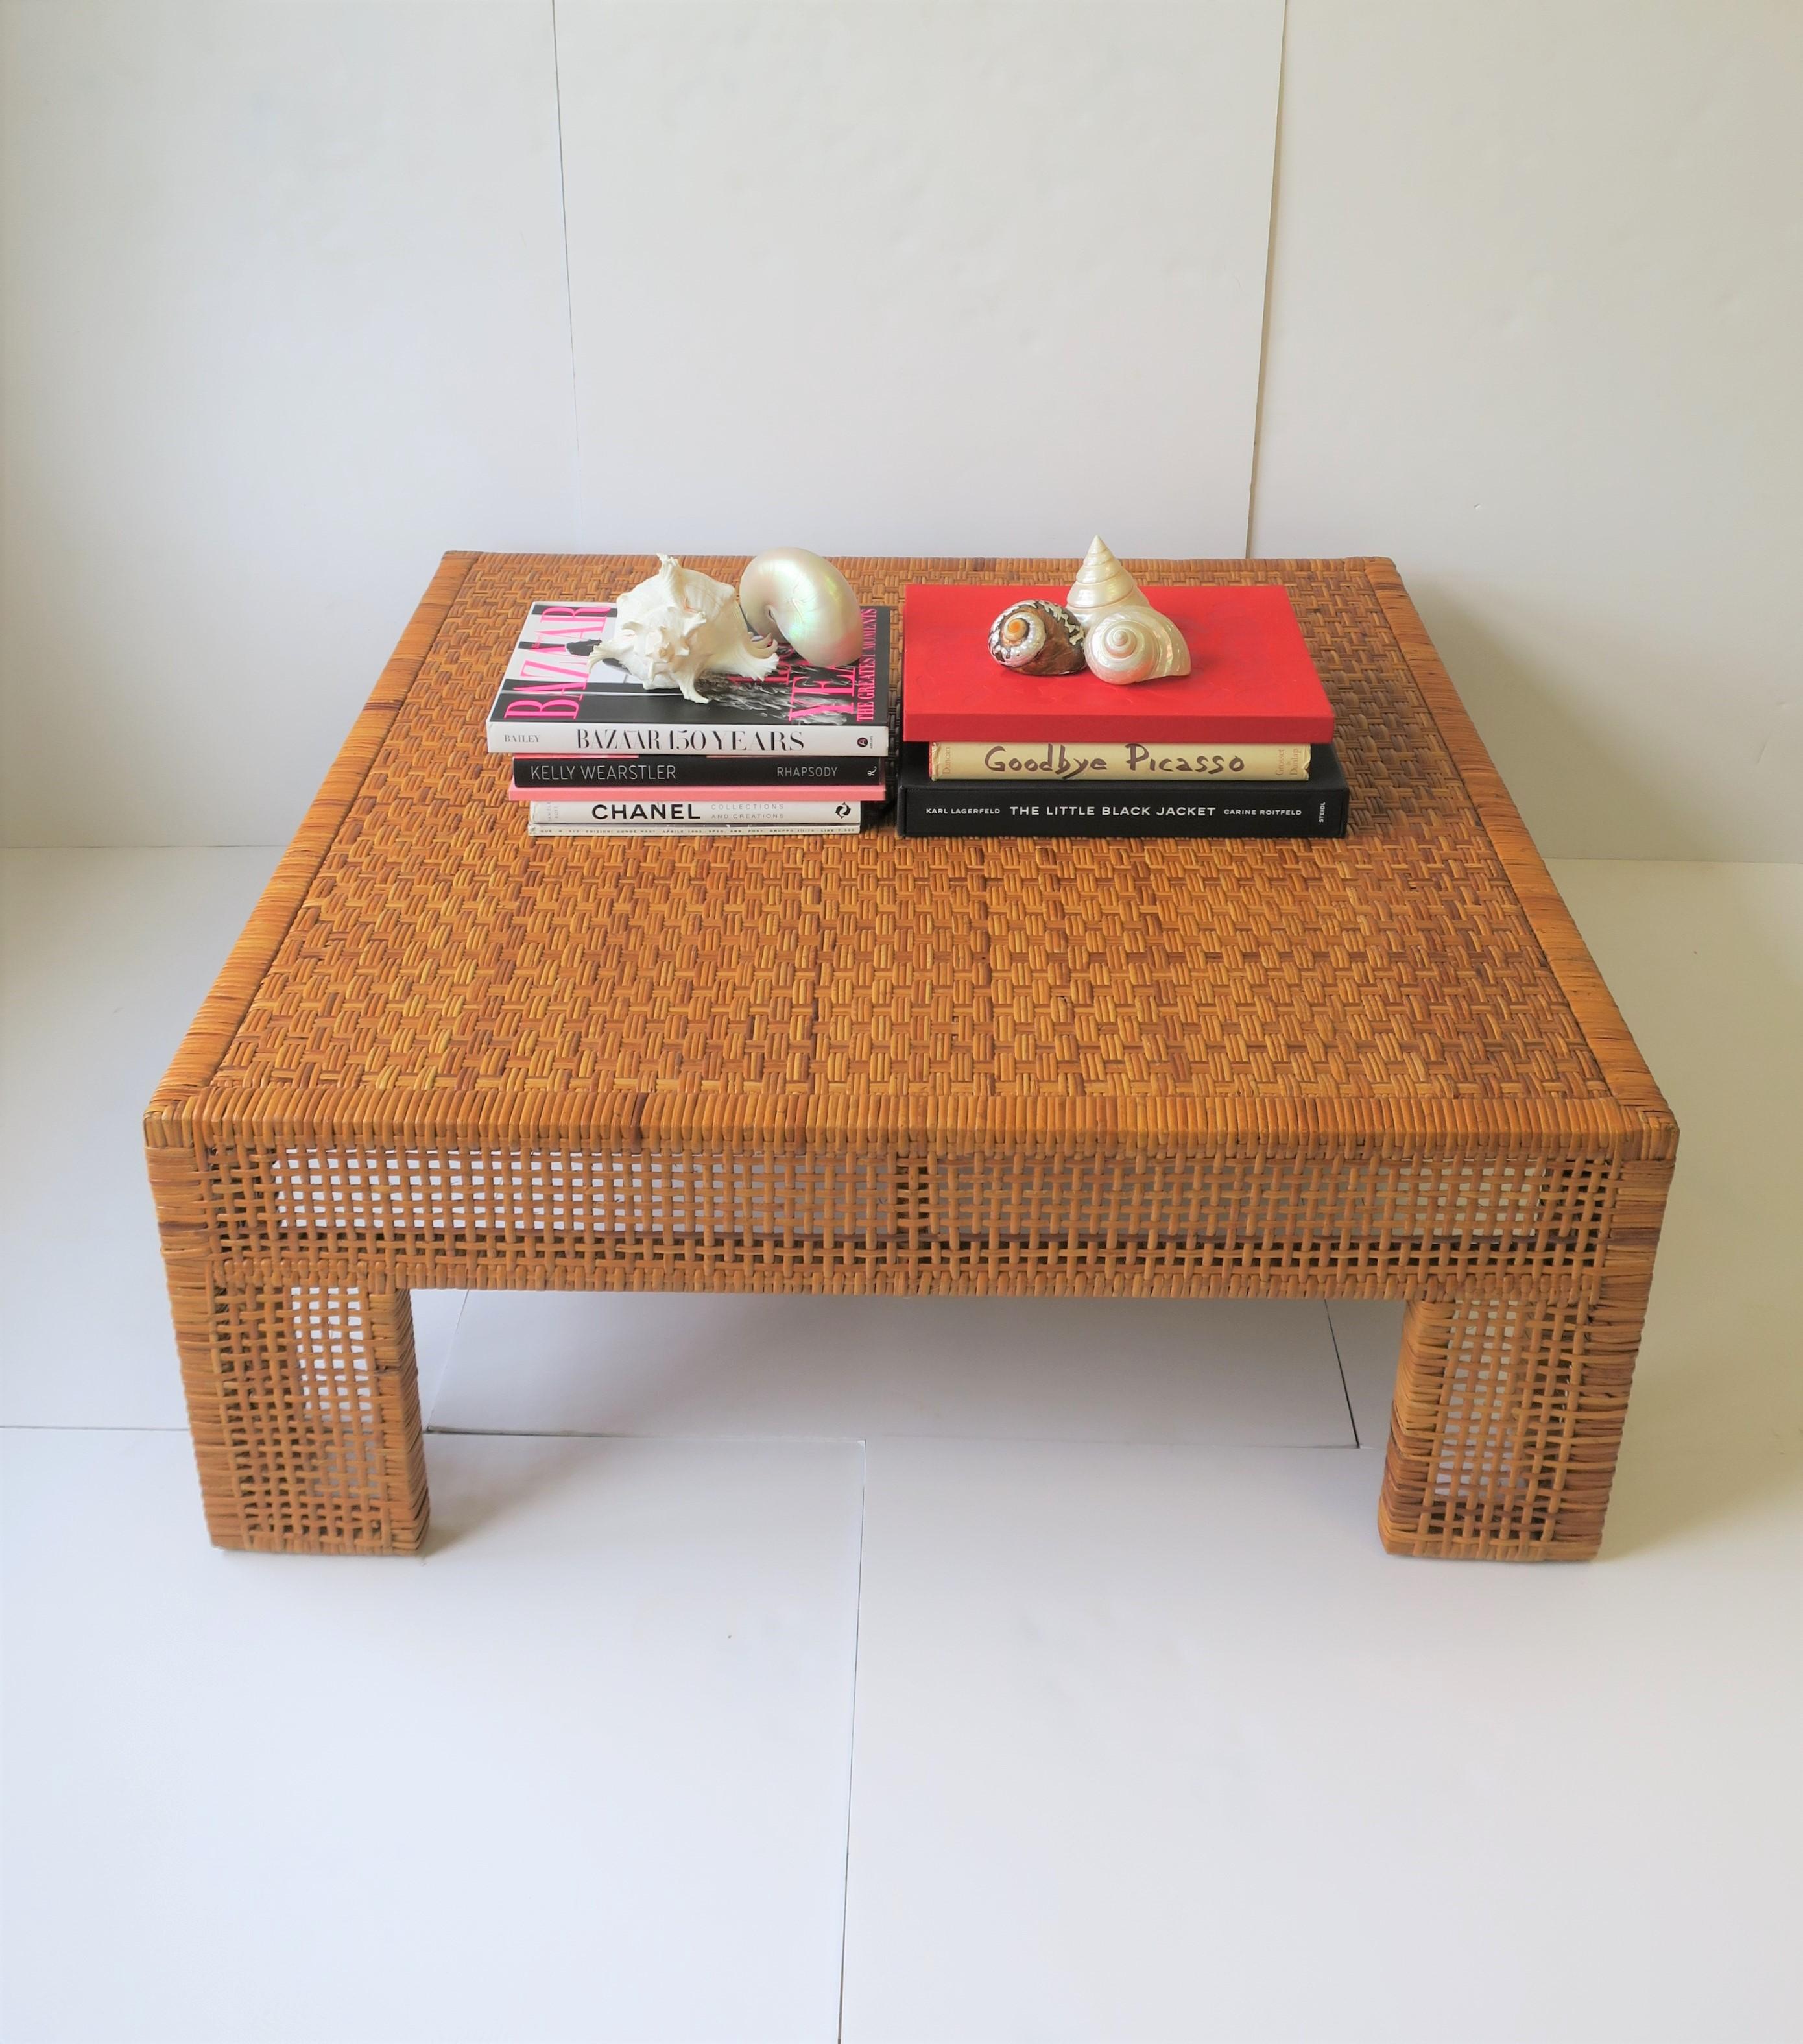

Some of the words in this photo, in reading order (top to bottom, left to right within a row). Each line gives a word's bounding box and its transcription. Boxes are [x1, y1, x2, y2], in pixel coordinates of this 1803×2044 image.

[861, 608, 877, 649] MOMENTS
[504, 605, 611, 719] BAZAAR
[857, 653, 876, 699] GREATEST
[857, 701, 874, 721] THE
[504, 734, 540, 743] BAILEY
[577, 728, 662, 750] BAZAAR
[669, 729, 706, 751] 150
[712, 730, 804, 751] YEARS
[531, 765, 576, 780] KELLY
[580, 765, 676, 780] WEARSTLER
[777, 766, 838, 777] RHAPSODY
[942, 747, 951, 775] Duncan
[984, 743, 1108, 780] Goodbye
[1123, 743, 1245, 775] Picasso
[1276, 749, 1284, 776] Grosset
[1289, 748, 1301, 776] Dunlap
[591, 804, 701, 820] CHANEL
[1009, 806, 1040, 816] THE
[1046, 806, 1095, 816] LITTLE
[1101, 806, 1151, 816] BLACK
[1156, 806, 1216, 816] JACKET
